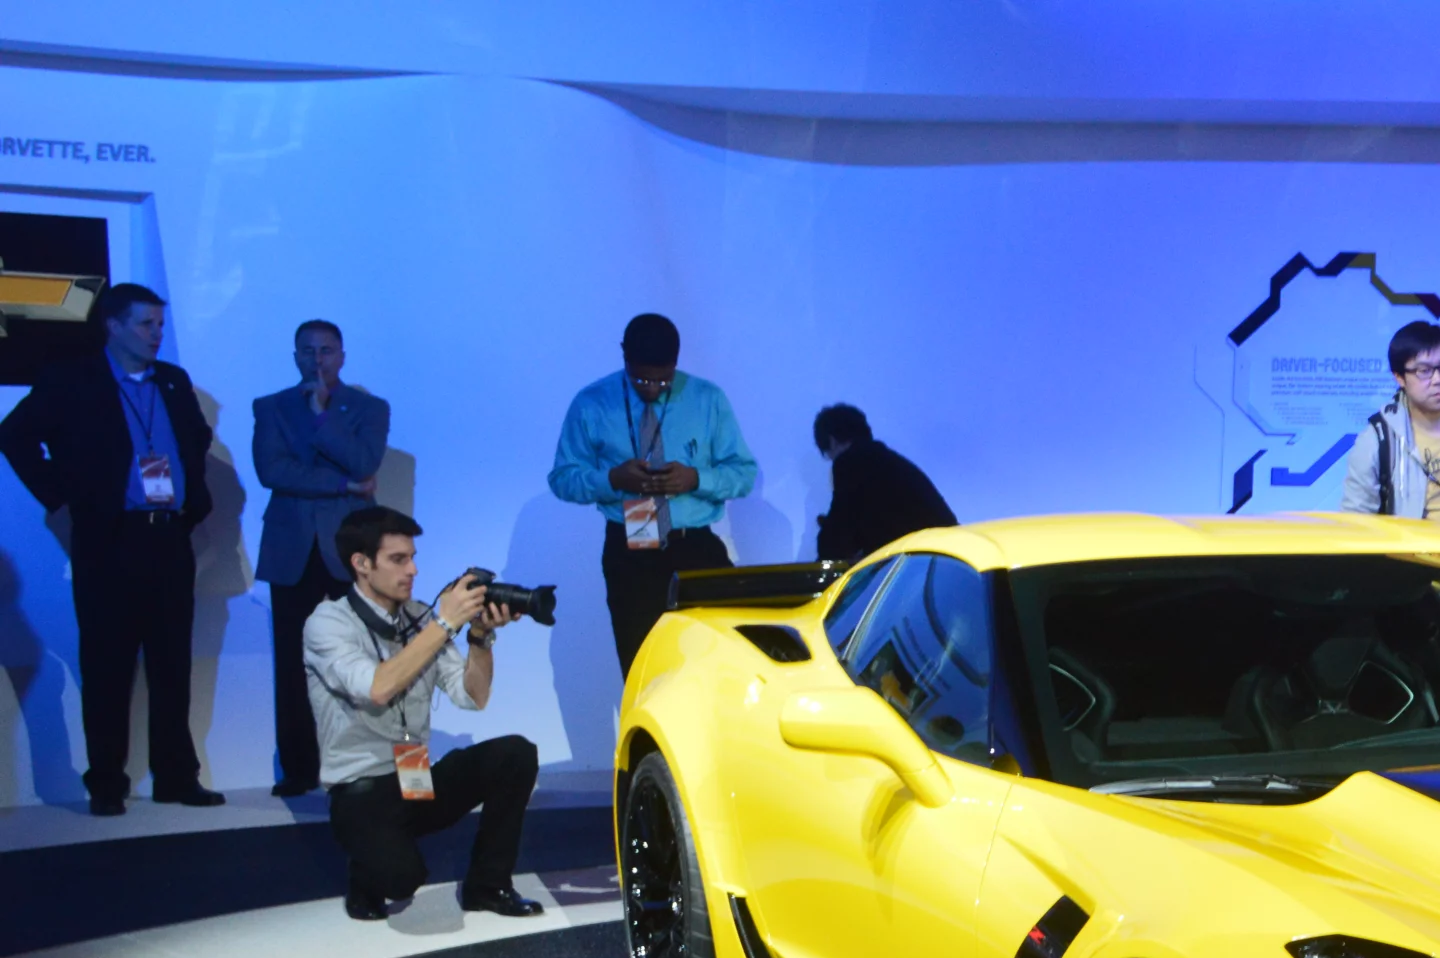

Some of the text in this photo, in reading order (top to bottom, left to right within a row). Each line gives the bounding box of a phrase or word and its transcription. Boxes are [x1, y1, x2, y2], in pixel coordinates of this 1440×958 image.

[0, 136, 156, 164] RVETTE, EVER.
[1272, 357, 1382, 372] DRIVER-FOCUSED
